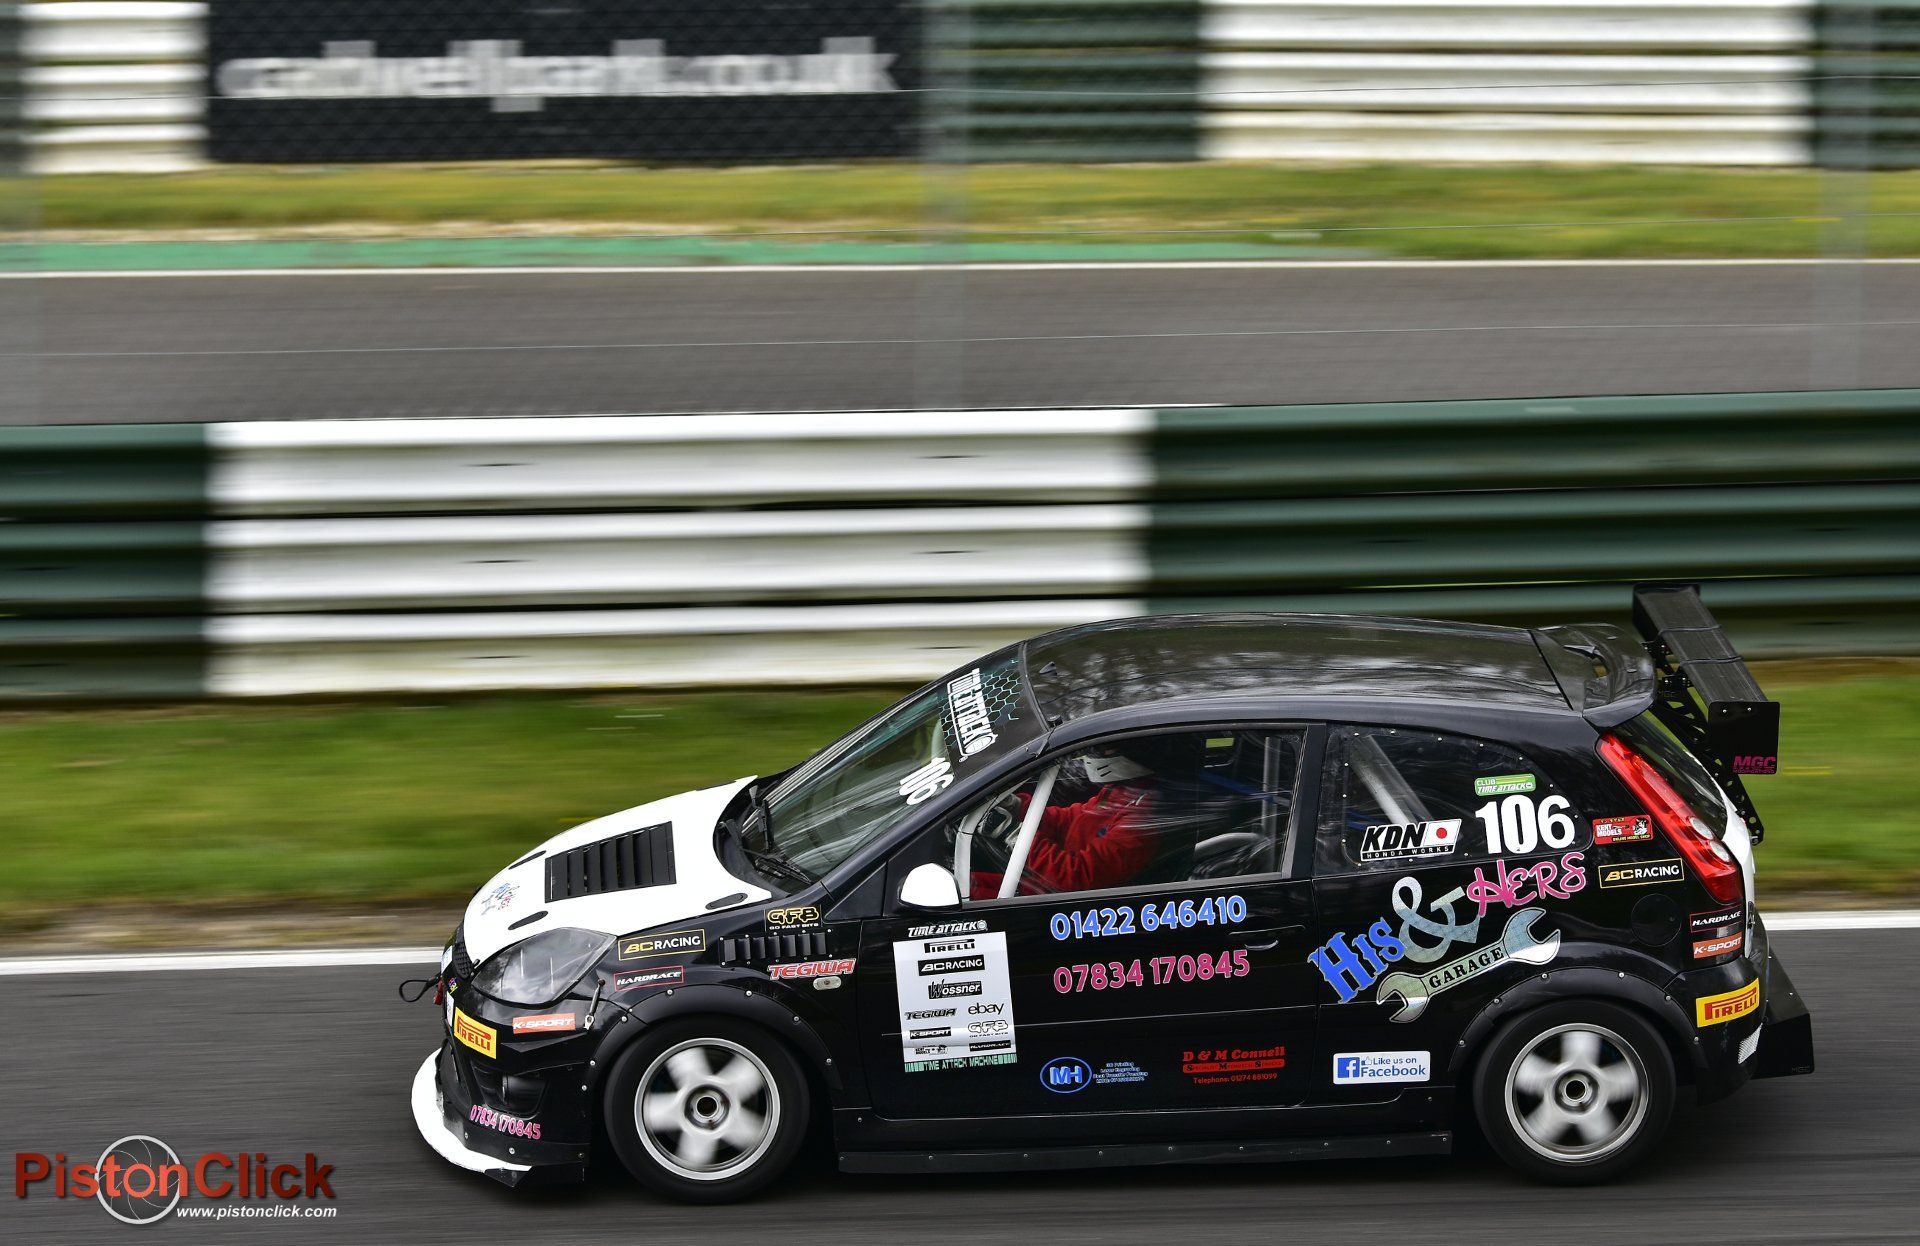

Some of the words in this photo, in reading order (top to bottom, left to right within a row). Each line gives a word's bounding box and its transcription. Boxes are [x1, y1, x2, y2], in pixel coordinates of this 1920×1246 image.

[1733, 755, 1776, 768] MGC
[899, 757, 953, 805] 106
[1475, 795, 1576, 855] 106
[1363, 822, 1427, 851] KDN
[1367, 851, 1403, 859] HONDA
[1412, 846, 1449, 855] WORKS
[767, 907, 820, 924] GFB
[1050, 906, 1135, 940] 01422
[1141, 895, 1247, 931] 646410
[1692, 911, 1741, 926] HARDRACE
[924, 939, 975, 953] PIRELLI
[1694, 937, 1742, 955] K-SPORT
[767, 958, 856, 980] TEGIWA
[1053, 959, 1143, 993] 07834
[1149, 949, 1250, 985] 170845
[1429, 947, 1504, 989] GARAGE
[616, 971, 682, 986] HARDRACE
[968, 1003, 1004, 1015] ebay
[1704, 987, 1757, 1020] PIRELLI
[904, 1008, 957, 1020] TEGIWA
[513, 1017, 575, 1030] K-SPORT
[456, 1015, 492, 1052] PIRELLI
[1182, 1051, 1194, 1061] D
[1198, 1050, 1211, 1060] &
[1214, 1049, 1228, 1060] M
[1231, 1046, 1285, 1059] Connell
[1373, 1057, 1390, 1065] Like
[1361, 1065, 1426, 1077] Facebook
[470, 1105, 498, 1129] 07834
[499, 1115, 541, 1139] 170845
